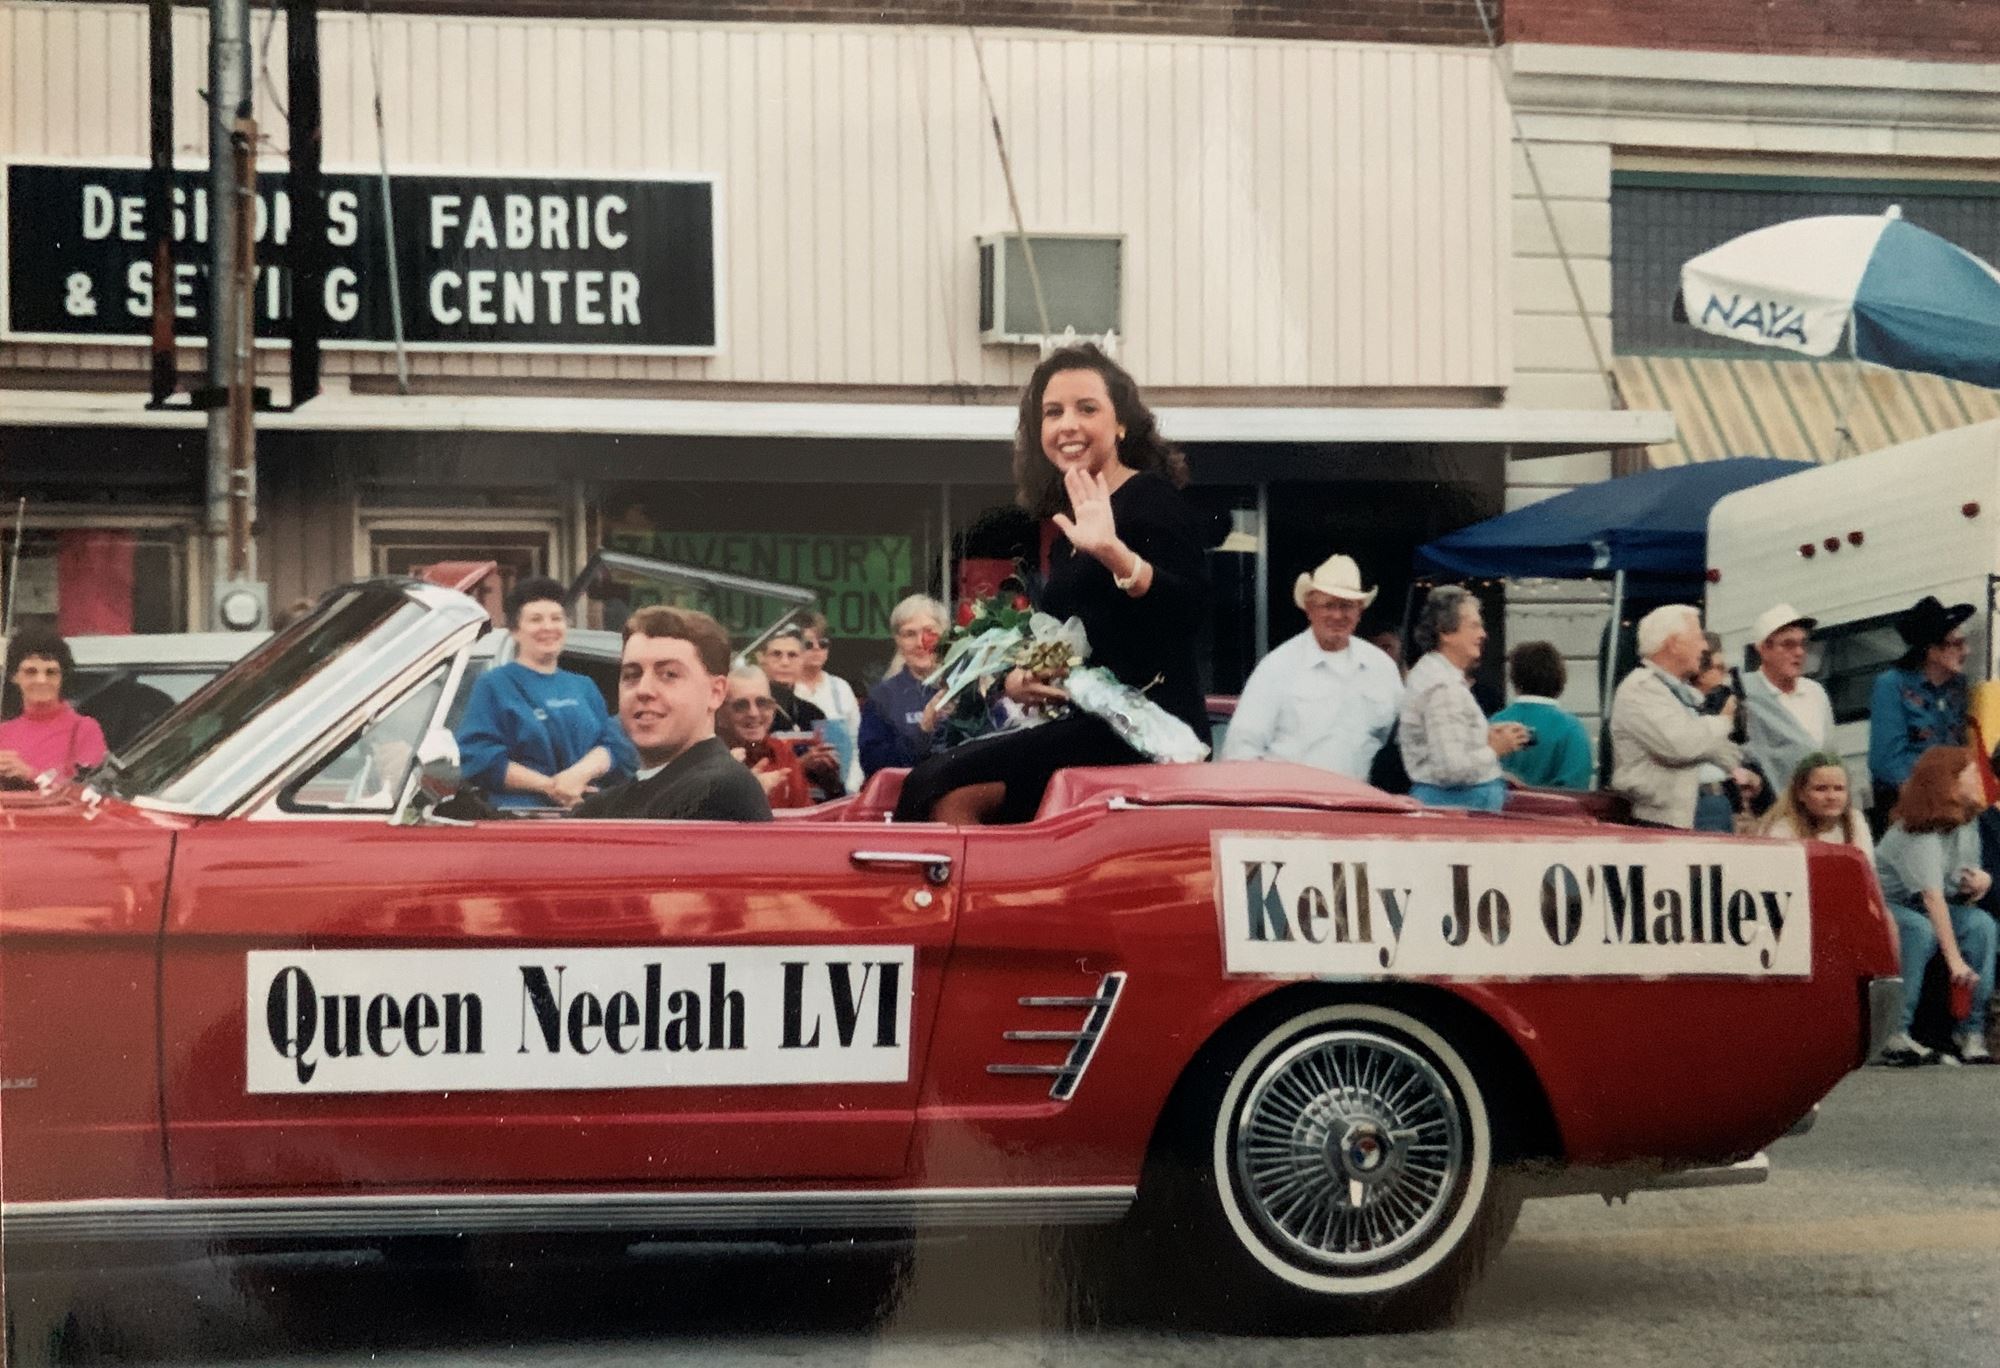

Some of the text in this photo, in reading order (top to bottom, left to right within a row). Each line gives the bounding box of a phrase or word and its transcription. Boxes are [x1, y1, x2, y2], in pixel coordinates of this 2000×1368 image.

[430, 193, 629, 250] FABRIC
[64, 260, 642, 325] & SEIG CENTER
[1702, 294, 1808, 345] NAYA
[1241, 860, 1793, 970] Kelly Jo O'Malley
[265, 960, 904, 1085] Queen Neelah LVI
